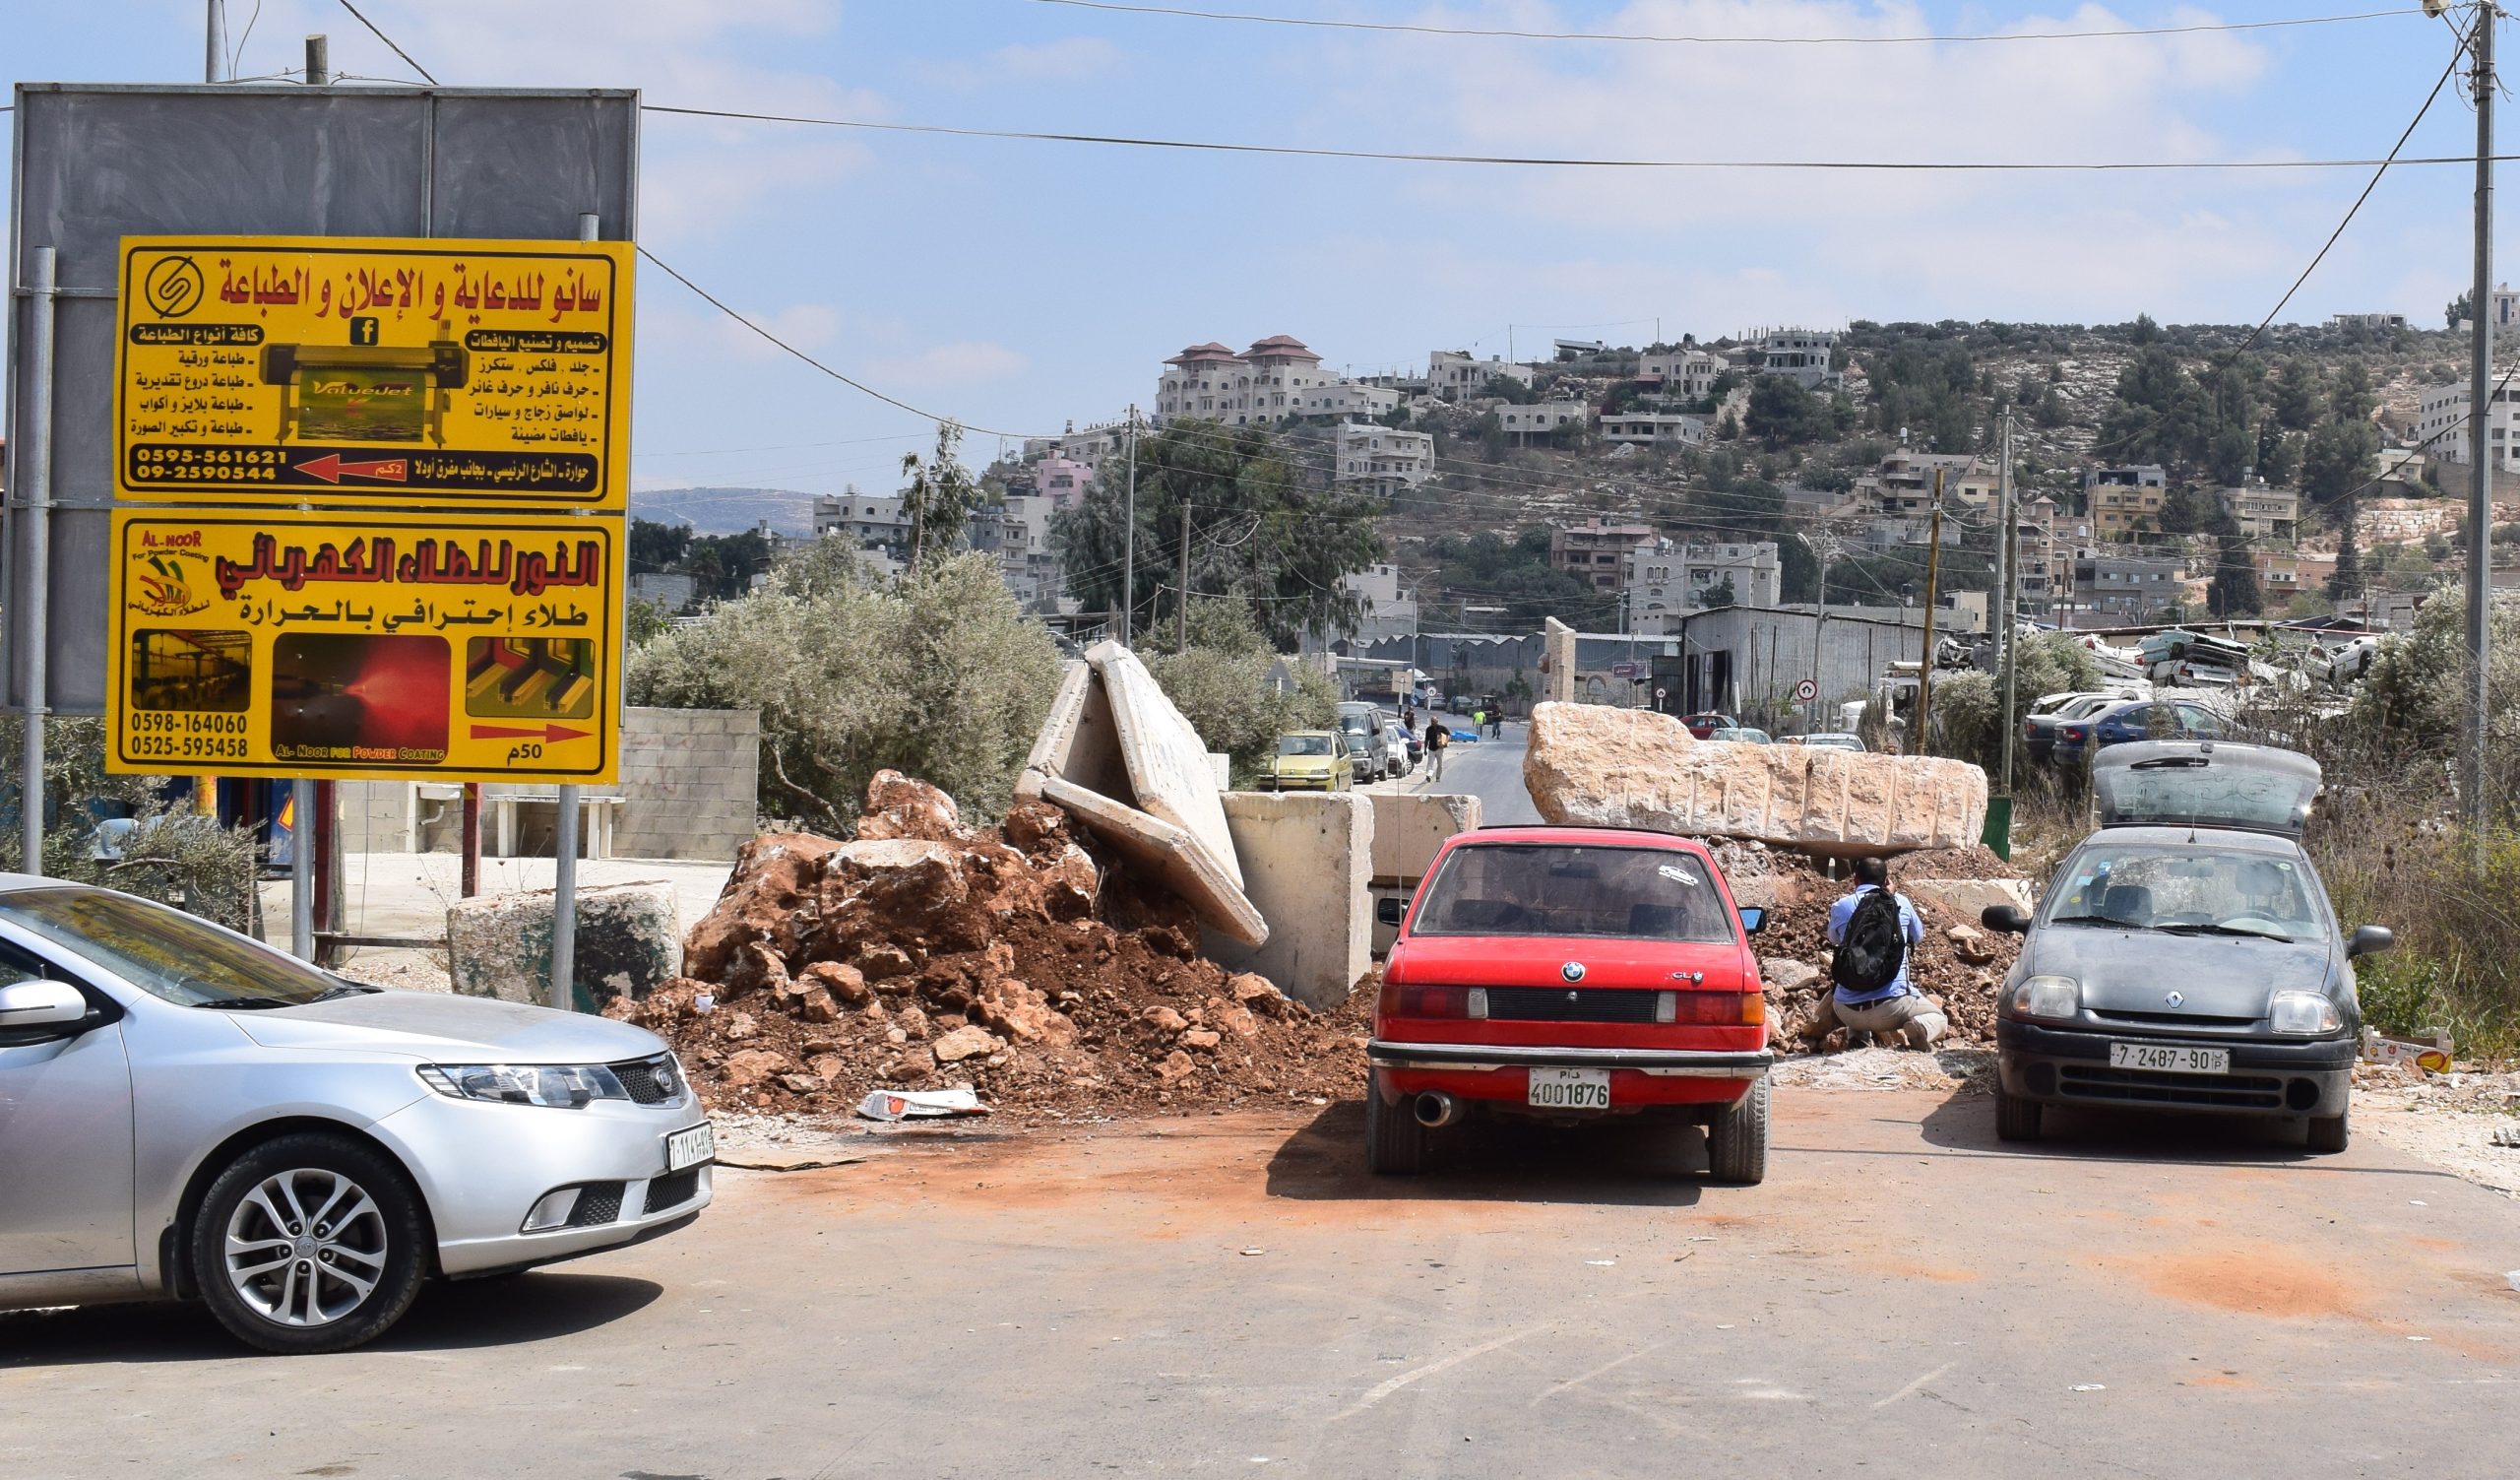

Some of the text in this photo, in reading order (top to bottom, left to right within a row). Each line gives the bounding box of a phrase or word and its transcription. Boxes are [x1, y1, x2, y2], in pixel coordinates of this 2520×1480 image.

[220, 258, 601, 325] سانو للدعاية و الإعلان و الطباعة
[138, 326, 259, 345] كافة أنواع الطباعة
[471, 333, 600, 353] تصميم و تصنيع اليافطات
[178, 351, 245, 367] طباعة ورقية
[478, 357, 590, 376] جلد فلكس ستكرز
[136, 372, 244, 391] طباعة دروع تقديرية
[497, 380, 524, 397] حرف
[536, 381, 559, 398] نافر
[563, 382, 589, 399] حرف
[527, 386, 534, 398] و
[140, 395, 244, 414] طباعة بلايز و أكواب
[474, 403, 589, 421] لواصق زجاج و سيارات
[130, 418, 243, 437] طباعة و تكبير الصورة
[549, 428, 588, 446] يافطات
[137, 449, 286, 464] 0595-561621
[137, 465, 277, 480] 09-2590544
[565, 462, 589, 482] حوارة
[142, 530, 202, 547] AL-NOOR
[180, 549, 209, 563] Coating
[215, 532, 599, 601] النور للطلاء الكهربائي
[240, 595, 589, 633] طلاء إحترافي بالحرارة
[132, 713, 246, 735] 0598-164060
[132, 736, 248, 756] 0525-595458
[1531, 1083, 1607, 1105] 4001876
